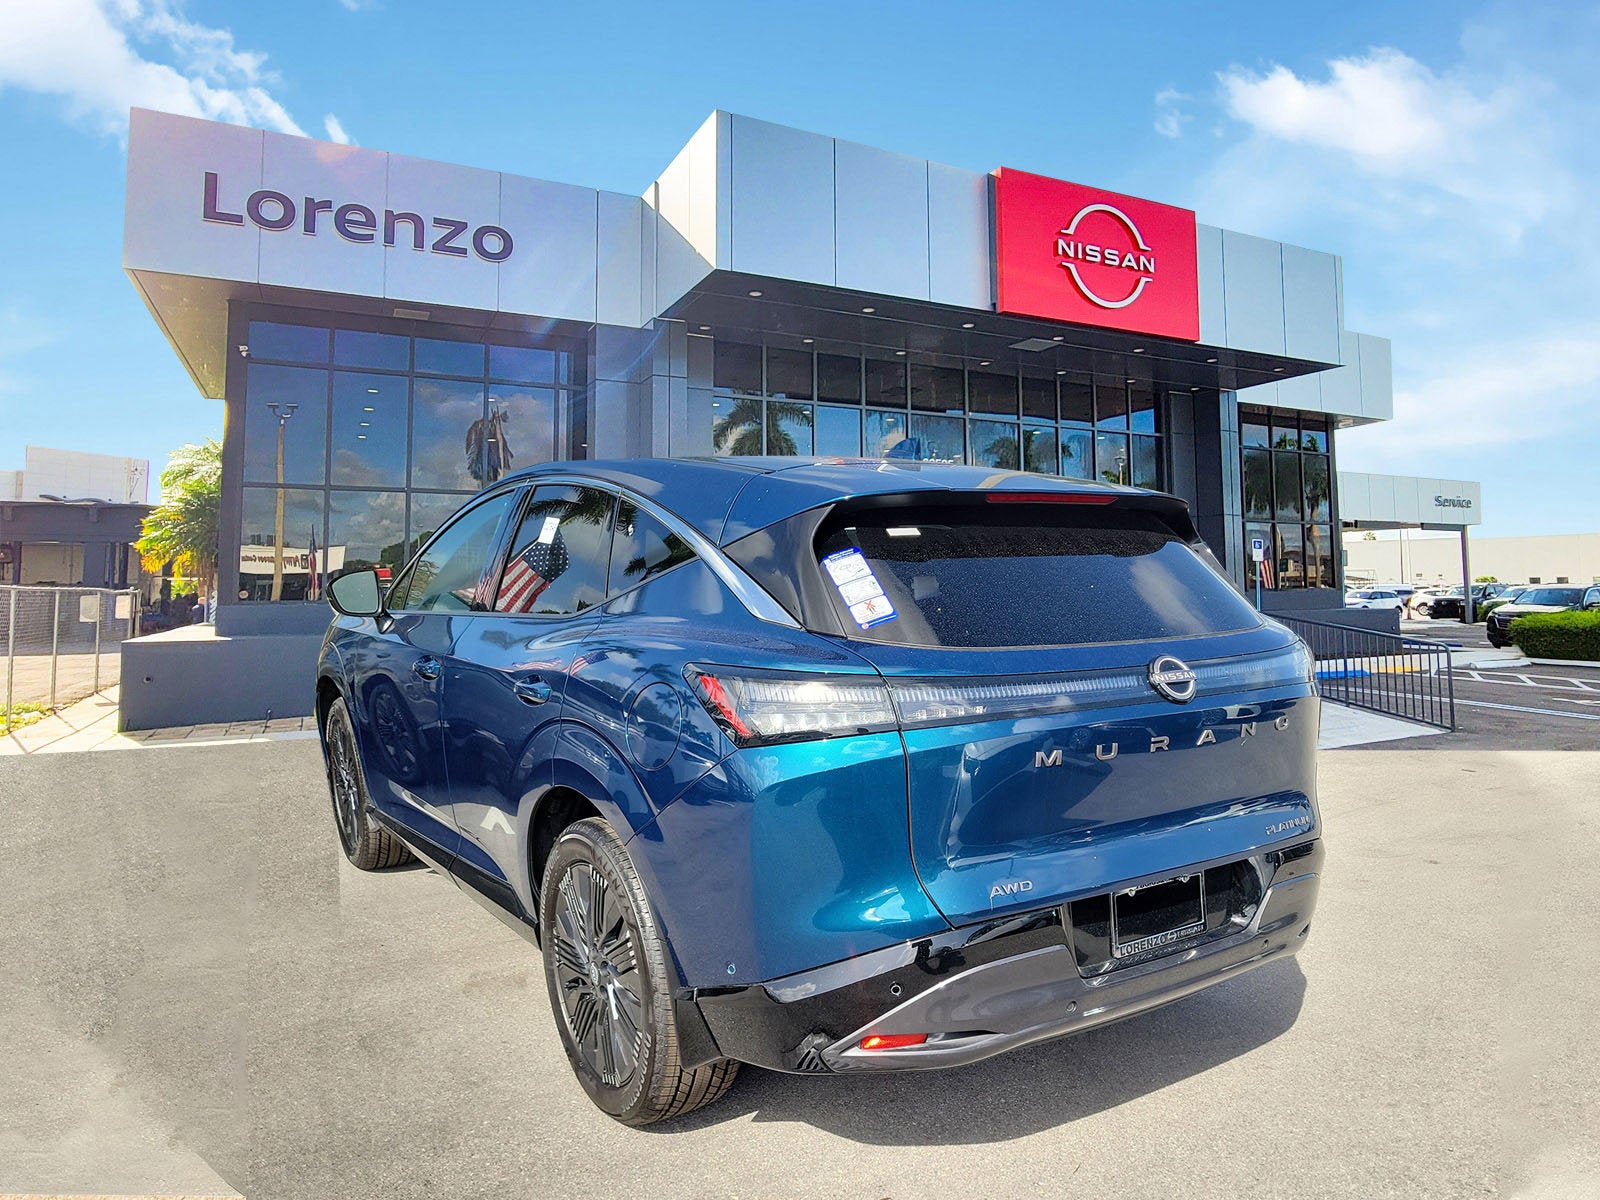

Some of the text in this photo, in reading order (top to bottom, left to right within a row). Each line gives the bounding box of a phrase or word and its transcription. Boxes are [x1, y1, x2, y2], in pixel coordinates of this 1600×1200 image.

[202, 171, 514, 262] Lorenzo
[1057, 238, 1155, 273] NISSAN
[1434, 495, 1472, 509] Service
[1153, 670, 1197, 683] NISSAN
[1034, 715, 1290, 768] MURANO
[1265, 815, 1310, 835] PLATINUM
[990, 880, 1033, 899] AWD
[1119, 934, 1167, 956] LORENZO
